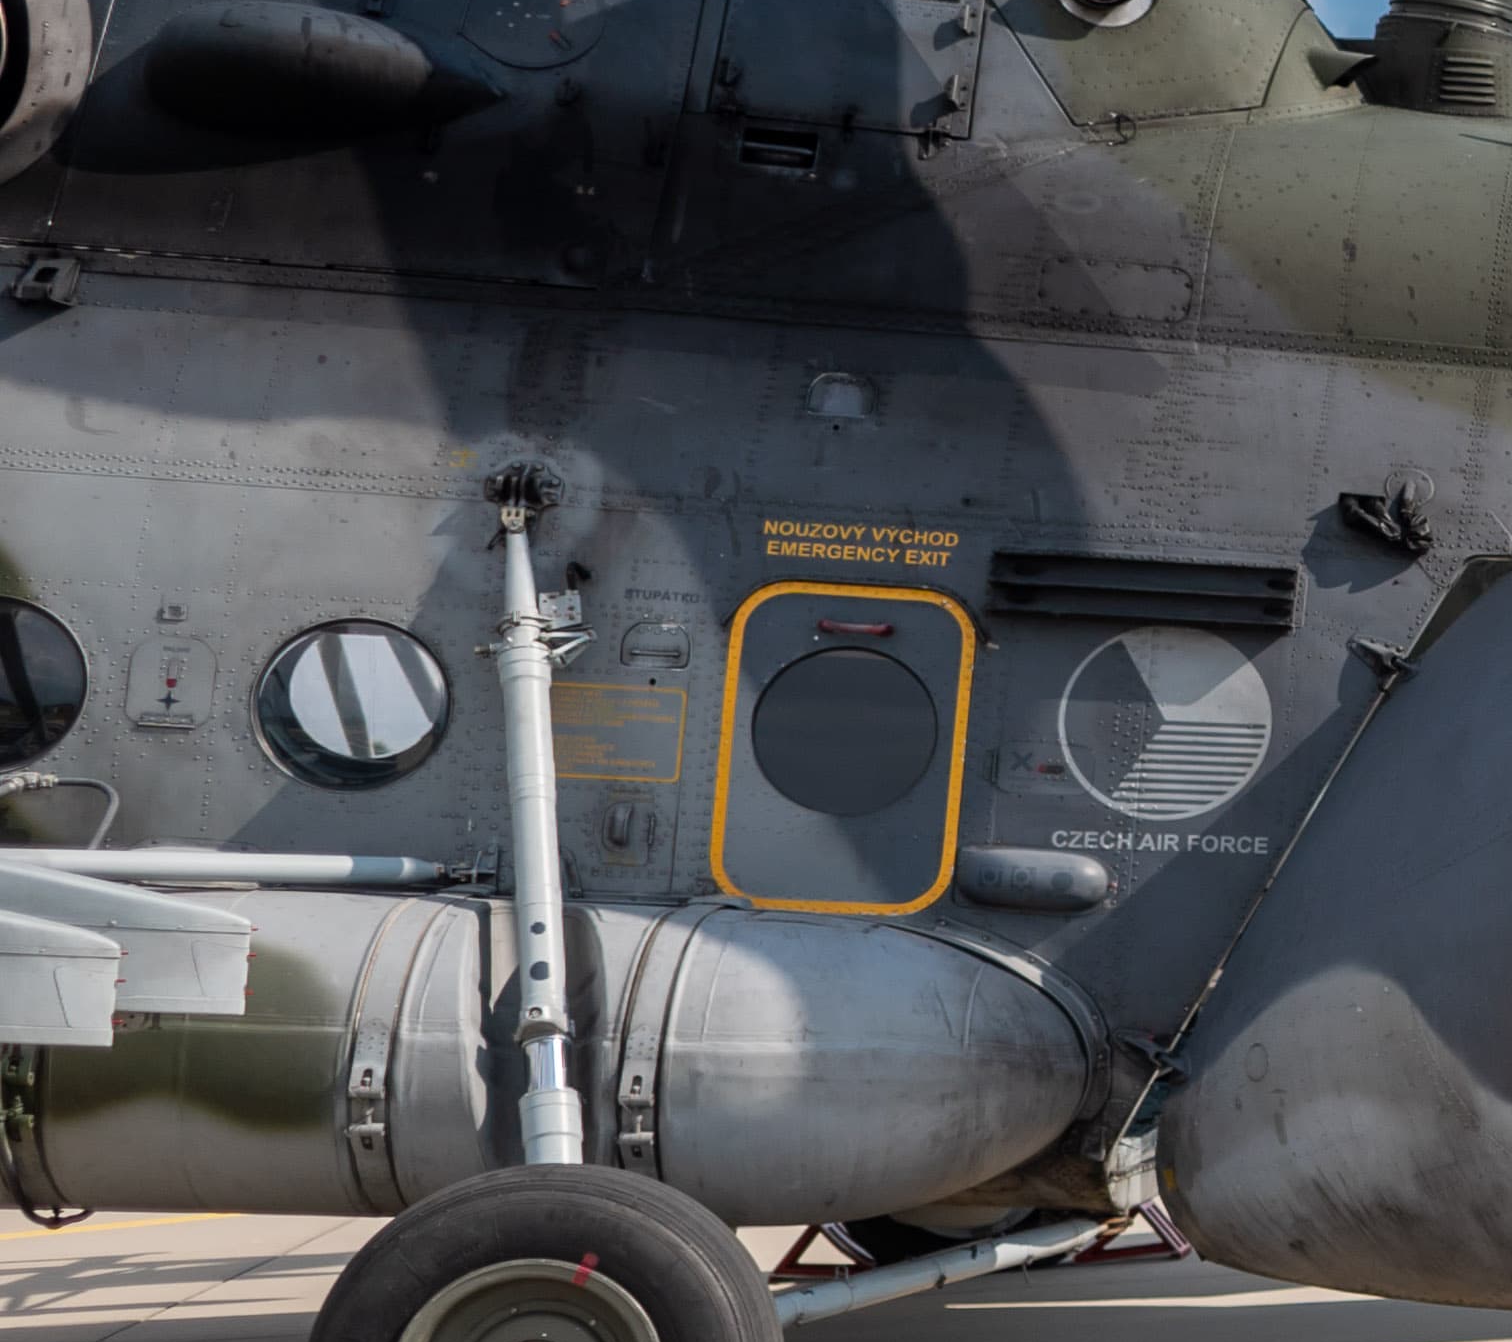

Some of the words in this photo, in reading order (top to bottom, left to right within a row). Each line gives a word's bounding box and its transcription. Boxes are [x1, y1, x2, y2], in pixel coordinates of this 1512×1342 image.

[763, 519, 866, 541] NOUZOVÝ
[872, 525, 960, 547] VÝCHOD
[766, 540, 900, 563] EMERGENCY
[905, 549, 951, 567] EXIT
[1051, 829, 1132, 850] CZECH
[1136, 832, 1180, 852] AIR
[1187, 834, 1269, 855] FORCE
